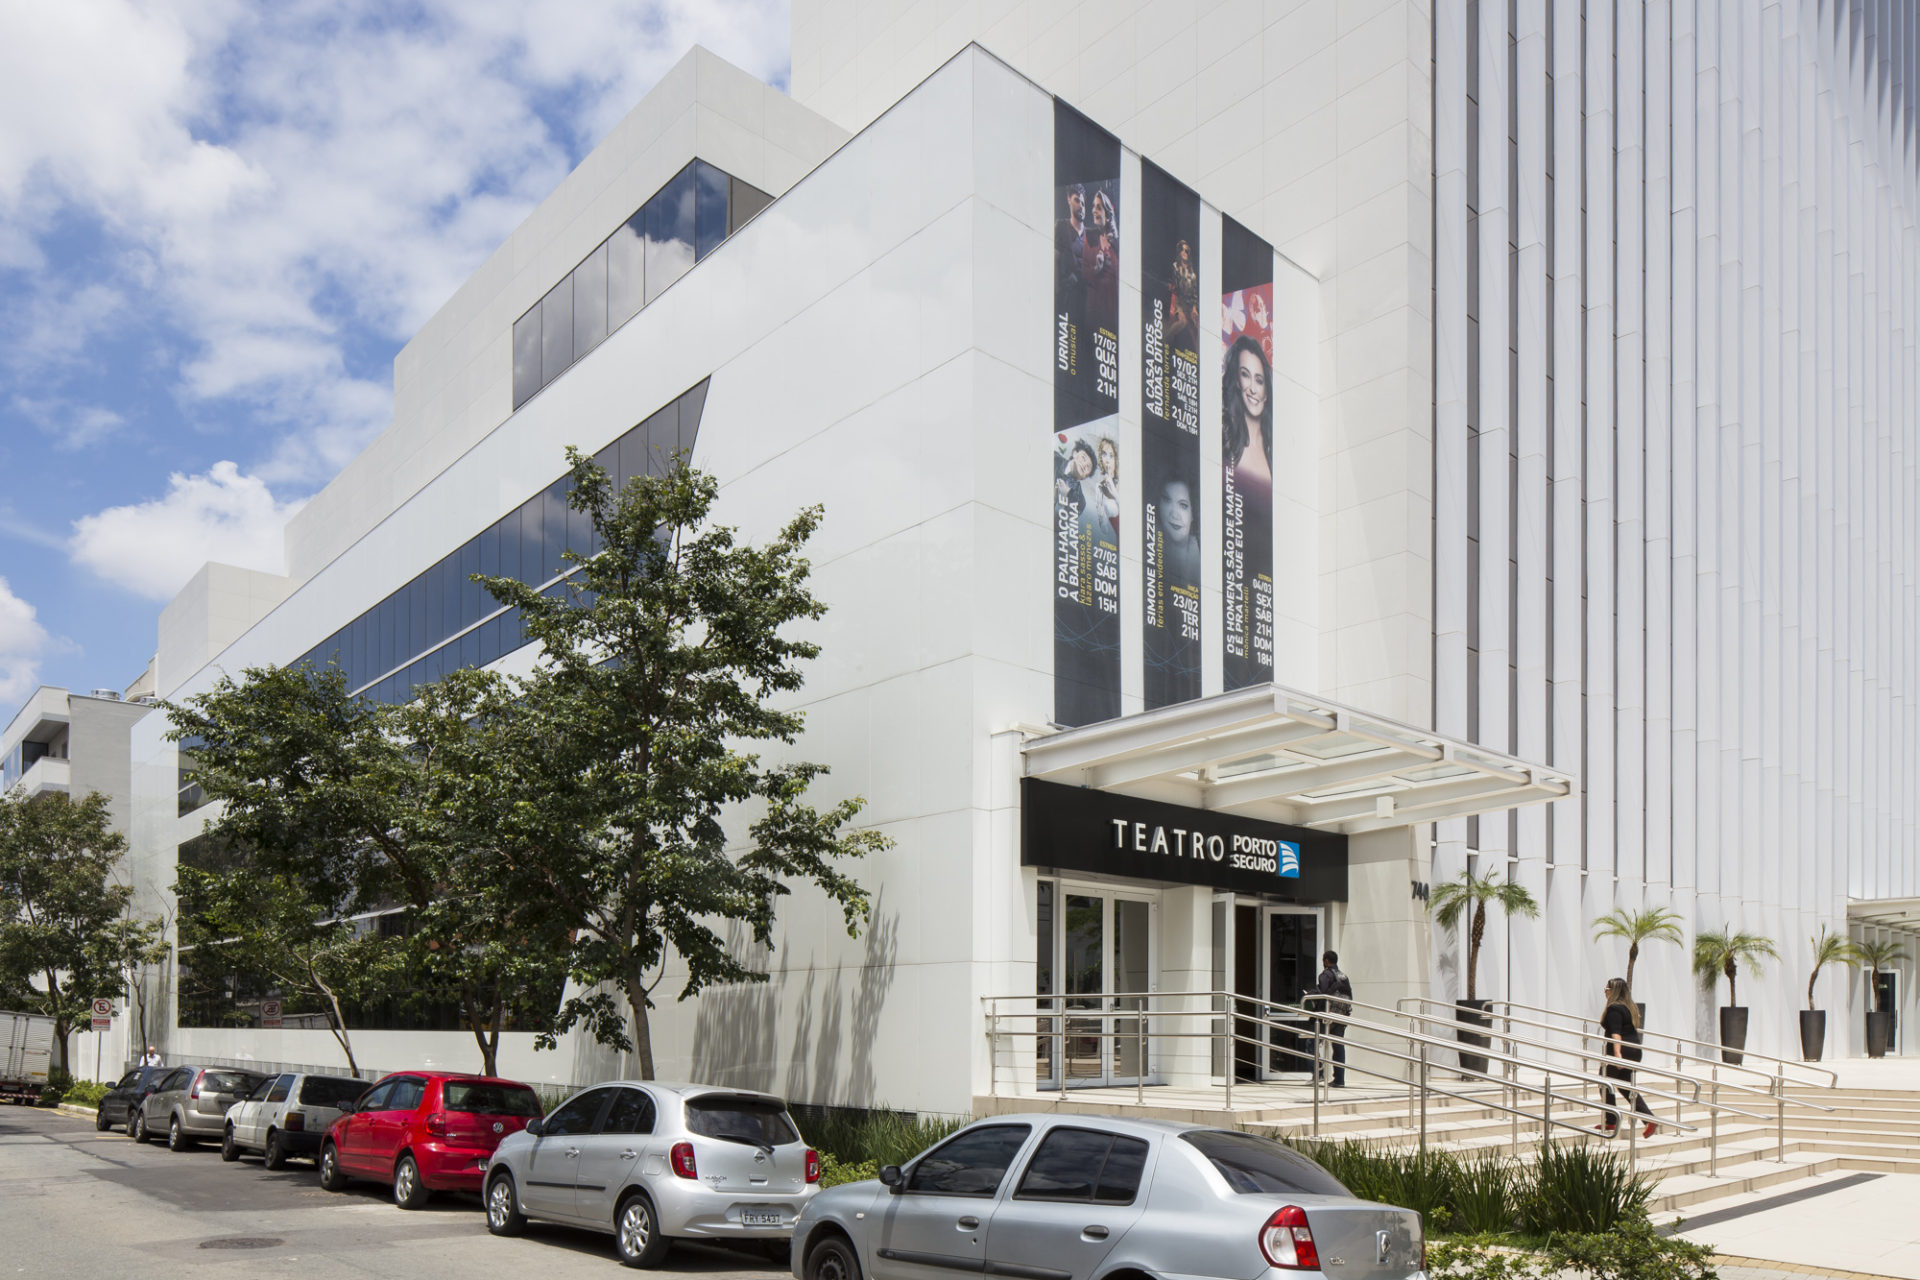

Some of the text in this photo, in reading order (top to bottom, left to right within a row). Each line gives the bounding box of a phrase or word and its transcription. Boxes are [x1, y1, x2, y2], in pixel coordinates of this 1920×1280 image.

[1059, 312, 1069, 371] URINAL
[1093, 332, 1117, 353] 17/02
[1095, 346, 1117, 368] QUA
[1154, 298, 1163, 418] BUDAS DITOSOS
[1172, 354, 1198, 379] 19/02
[1100, 363, 1117, 382] QUI
[1145, 323, 1155, 414] A CASA DOS
[1097, 378, 1117, 399] 21H
[1172, 376, 1198, 399] 20/02
[1172, 405, 1198, 428] 21/02
[1235, 493, 1244, 526] VOU!
[1226, 518, 1235, 538] DE
[1235, 528, 1243, 548] EU
[1058, 494, 1069, 598] O PALHAÇO E
[1069, 501, 1079, 603] A BAILARINA
[1093, 546, 1117, 565] 27/02
[1224, 540, 1235, 569] SÃO
[1096, 562, 1117, 580] SÁB
[1146, 503, 1156, 627] SIMONE MAZZER
[1235, 550, 1243, 579] QUE
[1095, 578, 1117, 597] DOM
[1157, 581, 1164, 597] em
[1252, 578, 1272, 594] 04/03
[1098, 596, 1117, 614] 15H
[1173, 593, 1199, 614] 23/02
[1226, 571, 1235, 631] HOMENS
[1256, 593, 1272, 609] SEX
[1181, 610, 1199, 628] TER
[1235, 604, 1243, 633] PRA
[1255, 606, 1272, 622] SÁB
[1182, 624, 1199, 641] 21H
[1256, 622, 1272, 637] 21H
[1226, 634, 1235, 654] OS
[1235, 645, 1243, 657] E
[1254, 636, 1272, 652] DOM
[1257, 652, 1272, 667] 18H
[1111, 818, 1225, 862] TEATRO
[1232, 834, 1277, 858] PORTO
[1231, 854, 1277, 873] SEGURO
[761, 1214, 780, 1223] 5437
